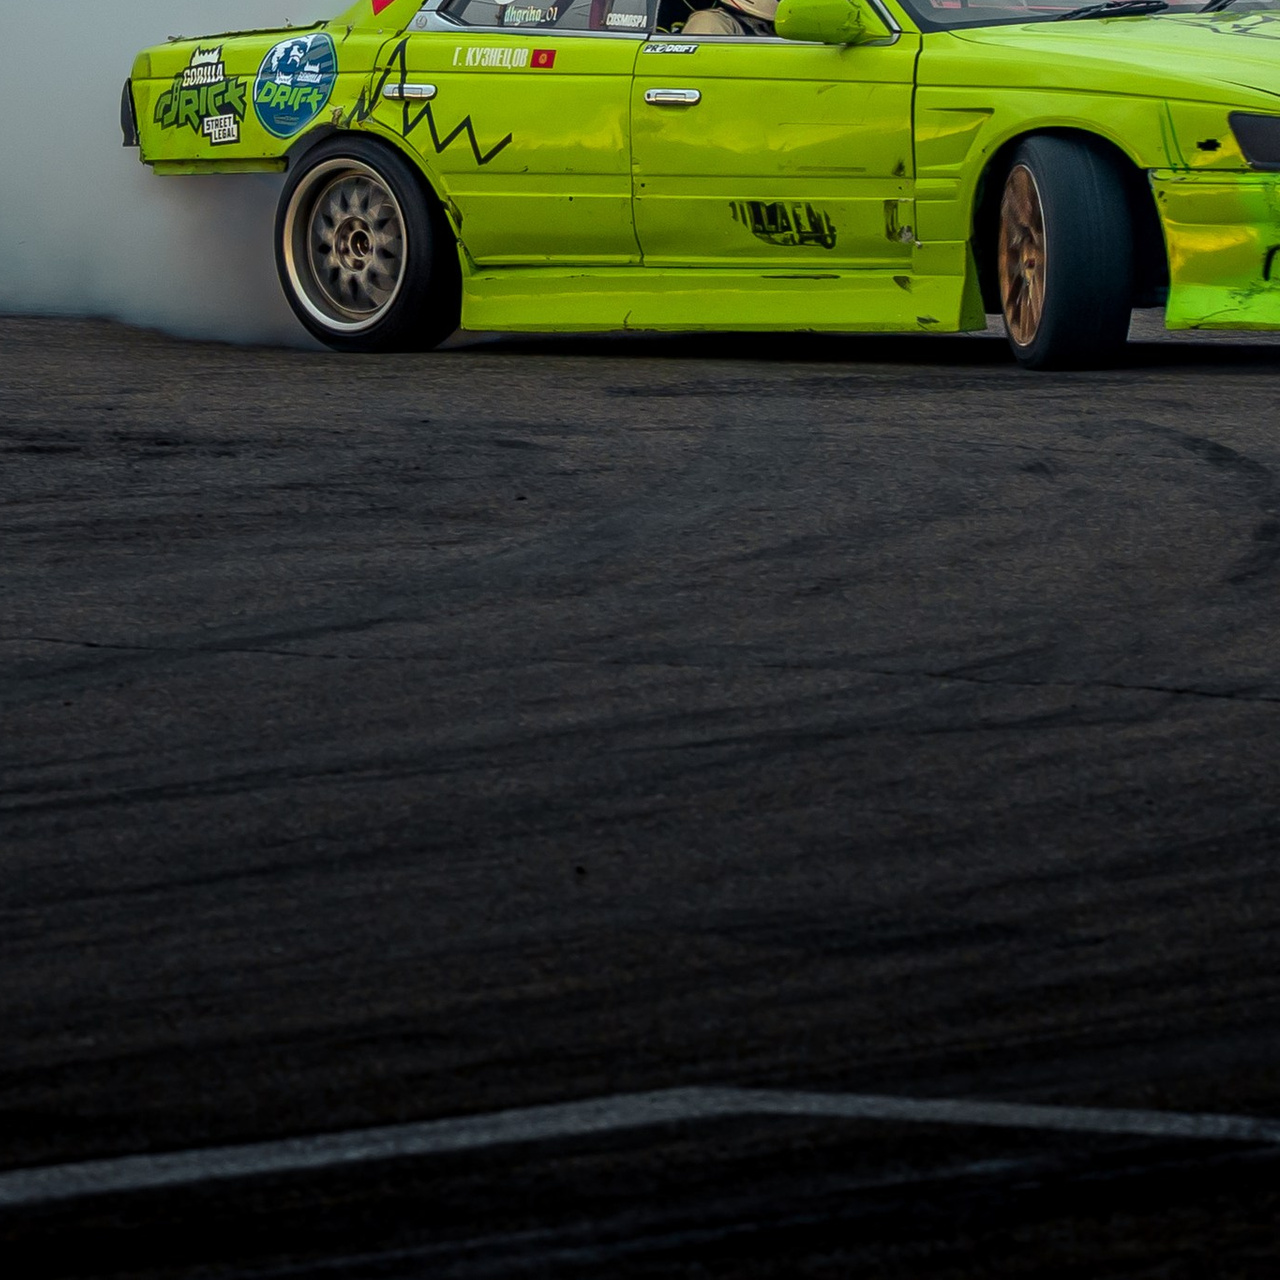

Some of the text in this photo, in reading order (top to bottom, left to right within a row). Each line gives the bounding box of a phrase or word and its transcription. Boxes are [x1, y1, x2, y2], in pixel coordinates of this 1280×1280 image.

[453, 47, 528, 69] Г. КУЗНЕЦОВ
[182, 63, 224, 87] GORILLA
[256, 80, 323, 114] DRIFT
[206, 117, 232, 131] STREET
[214, 126, 236, 140] LEGAL
